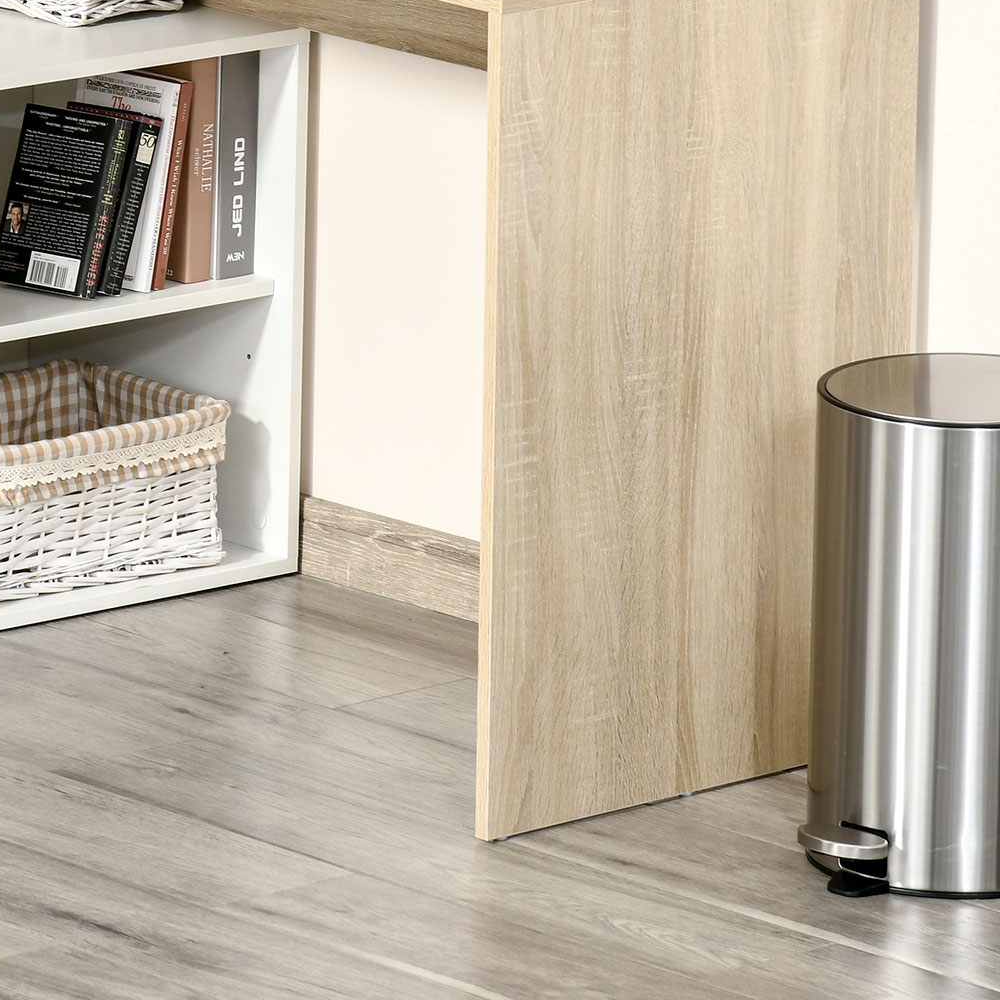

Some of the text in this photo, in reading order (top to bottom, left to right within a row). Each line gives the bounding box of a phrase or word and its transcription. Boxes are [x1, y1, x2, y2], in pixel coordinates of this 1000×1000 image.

[112, 96, 131, 110] The
[140, 134, 157, 148] 50
[200, 123, 214, 193] NATHALIE
[232, 137, 245, 237] JED LIND
[226, 250, 244, 262] NEW
